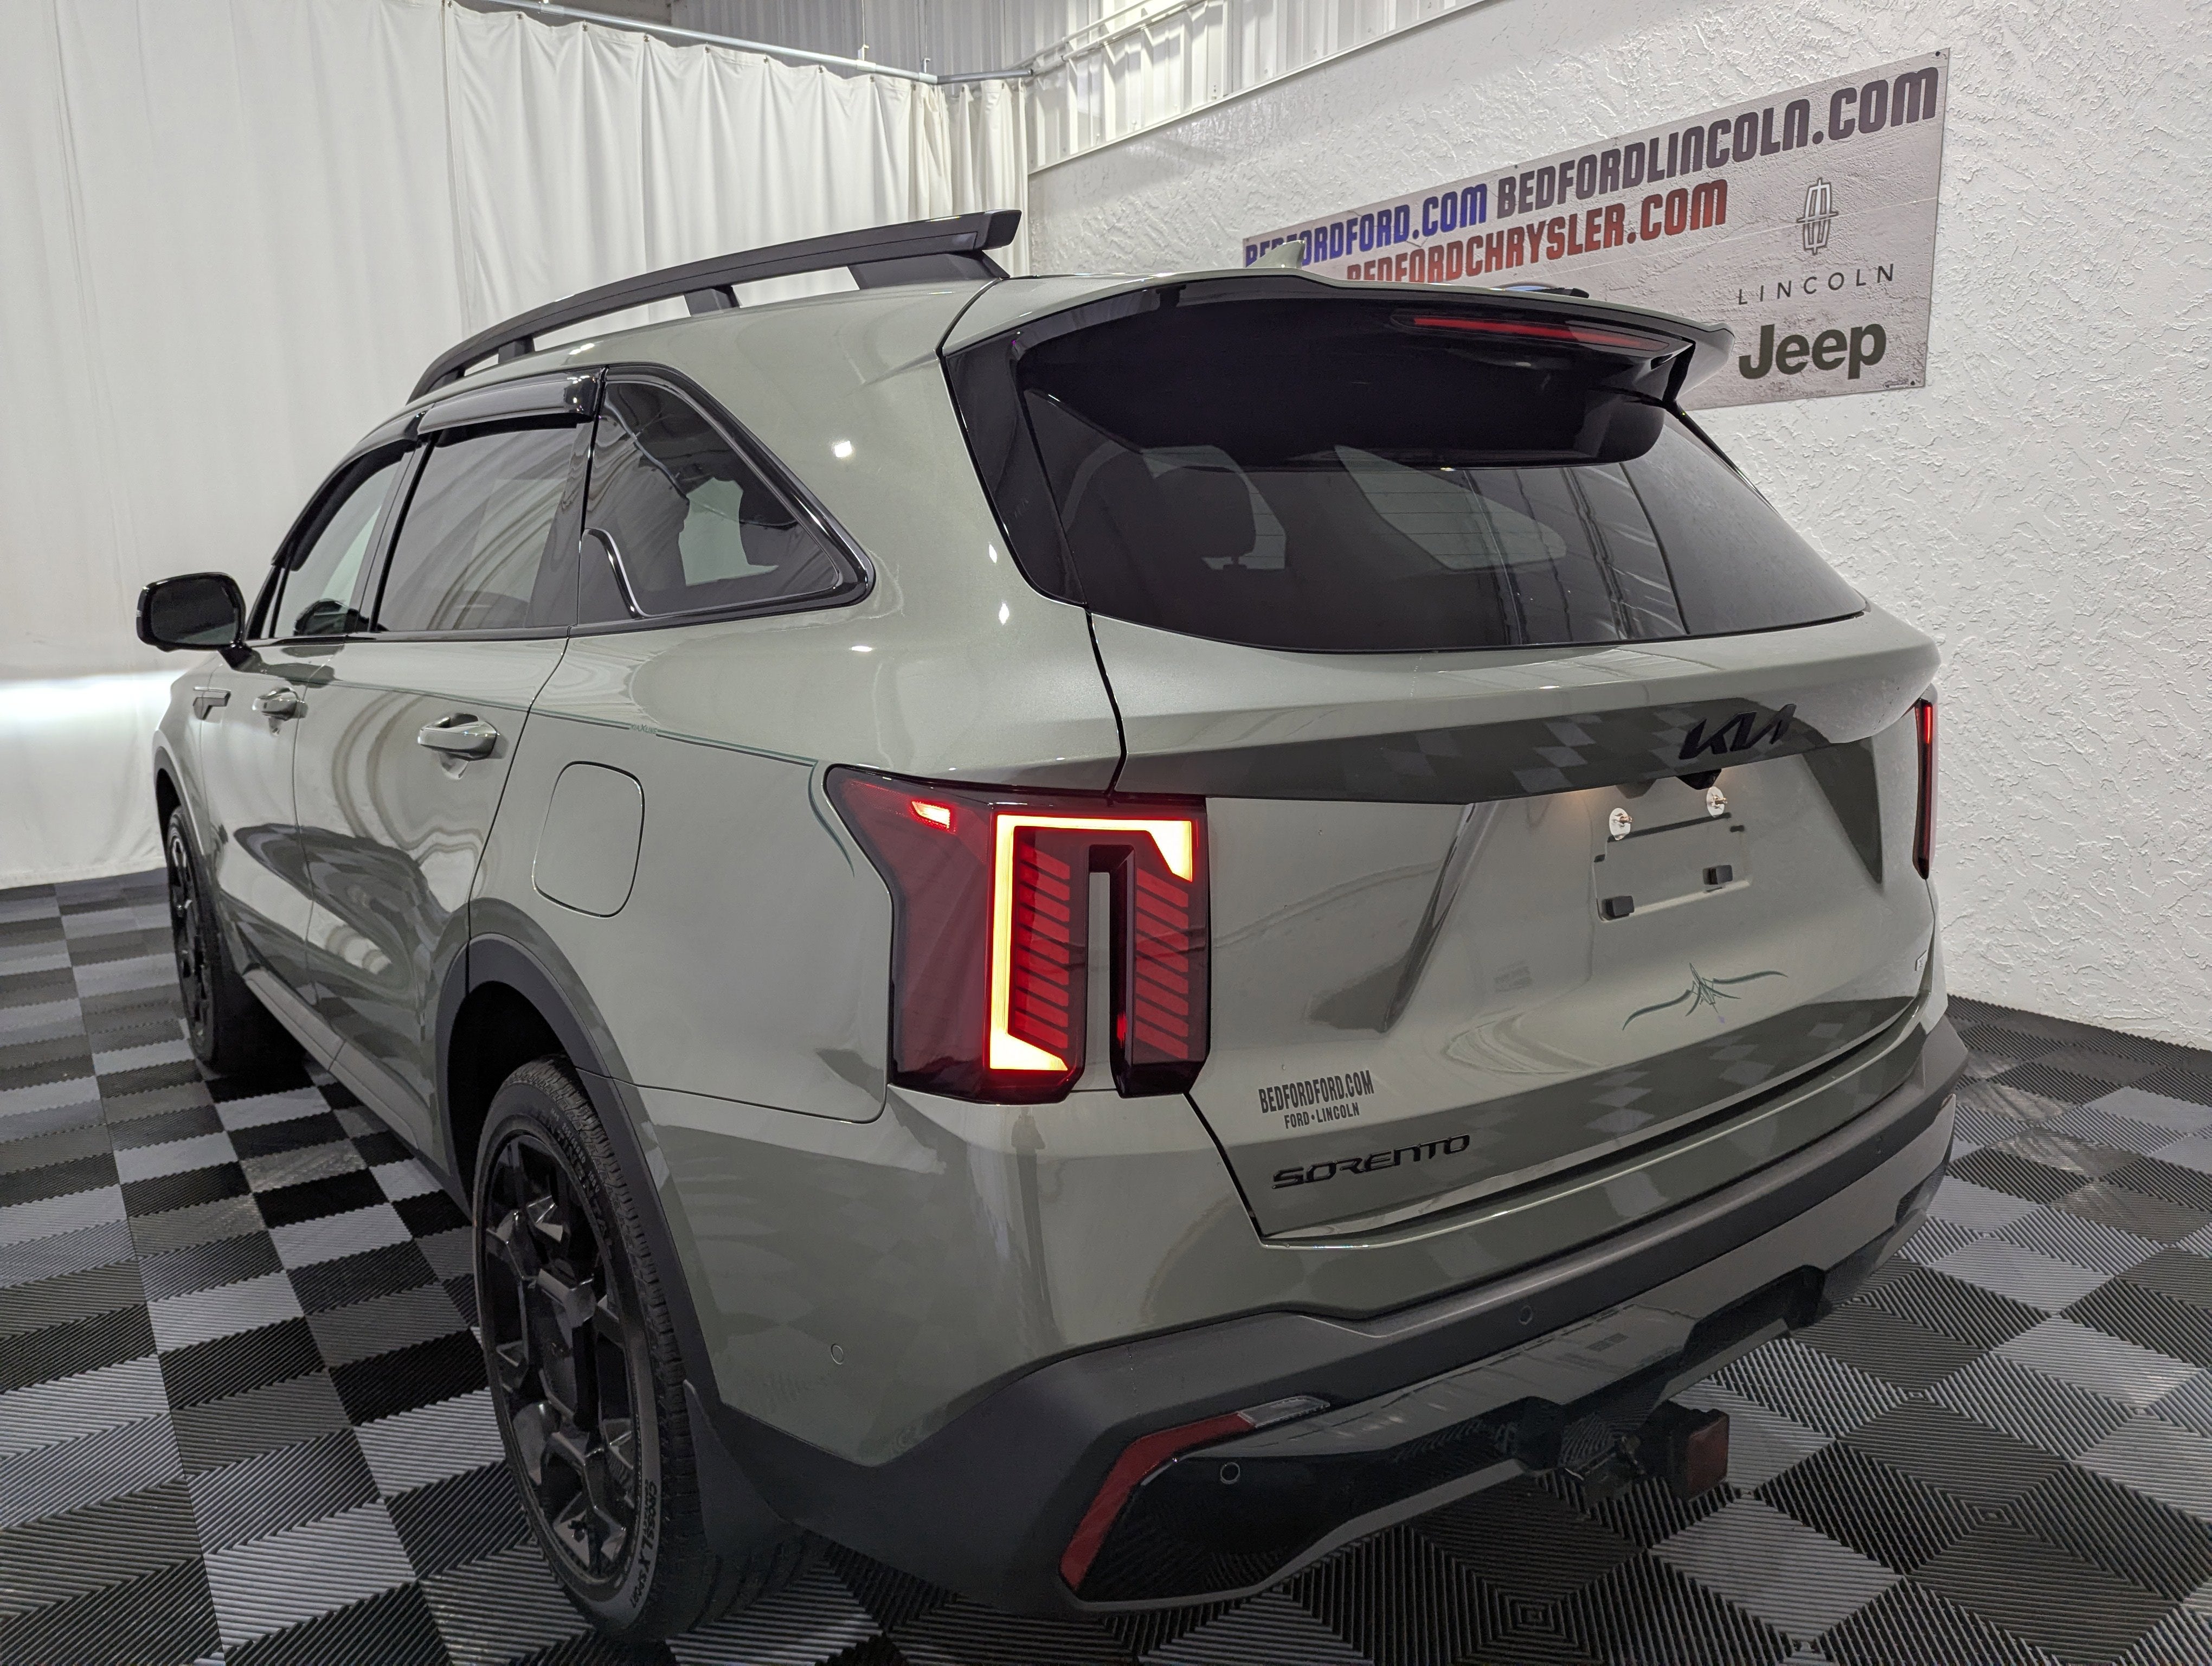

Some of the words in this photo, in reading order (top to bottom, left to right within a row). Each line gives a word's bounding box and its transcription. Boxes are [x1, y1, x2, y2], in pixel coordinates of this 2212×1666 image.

[1246, 183, 1488, 267] BORDFORD.COM
[1497, 67, 1939, 219] BEDFORDLINCOLN.COM
[1738, 263, 1894, 305] LINCOLN
[1739, 324, 1886, 380] Jeep
[1679, 703, 1797, 759] KIA
[1258, 1070, 1374, 1113] BEDFORDFORD.COM
[1271, 1134, 1470, 1189] SORENTO
